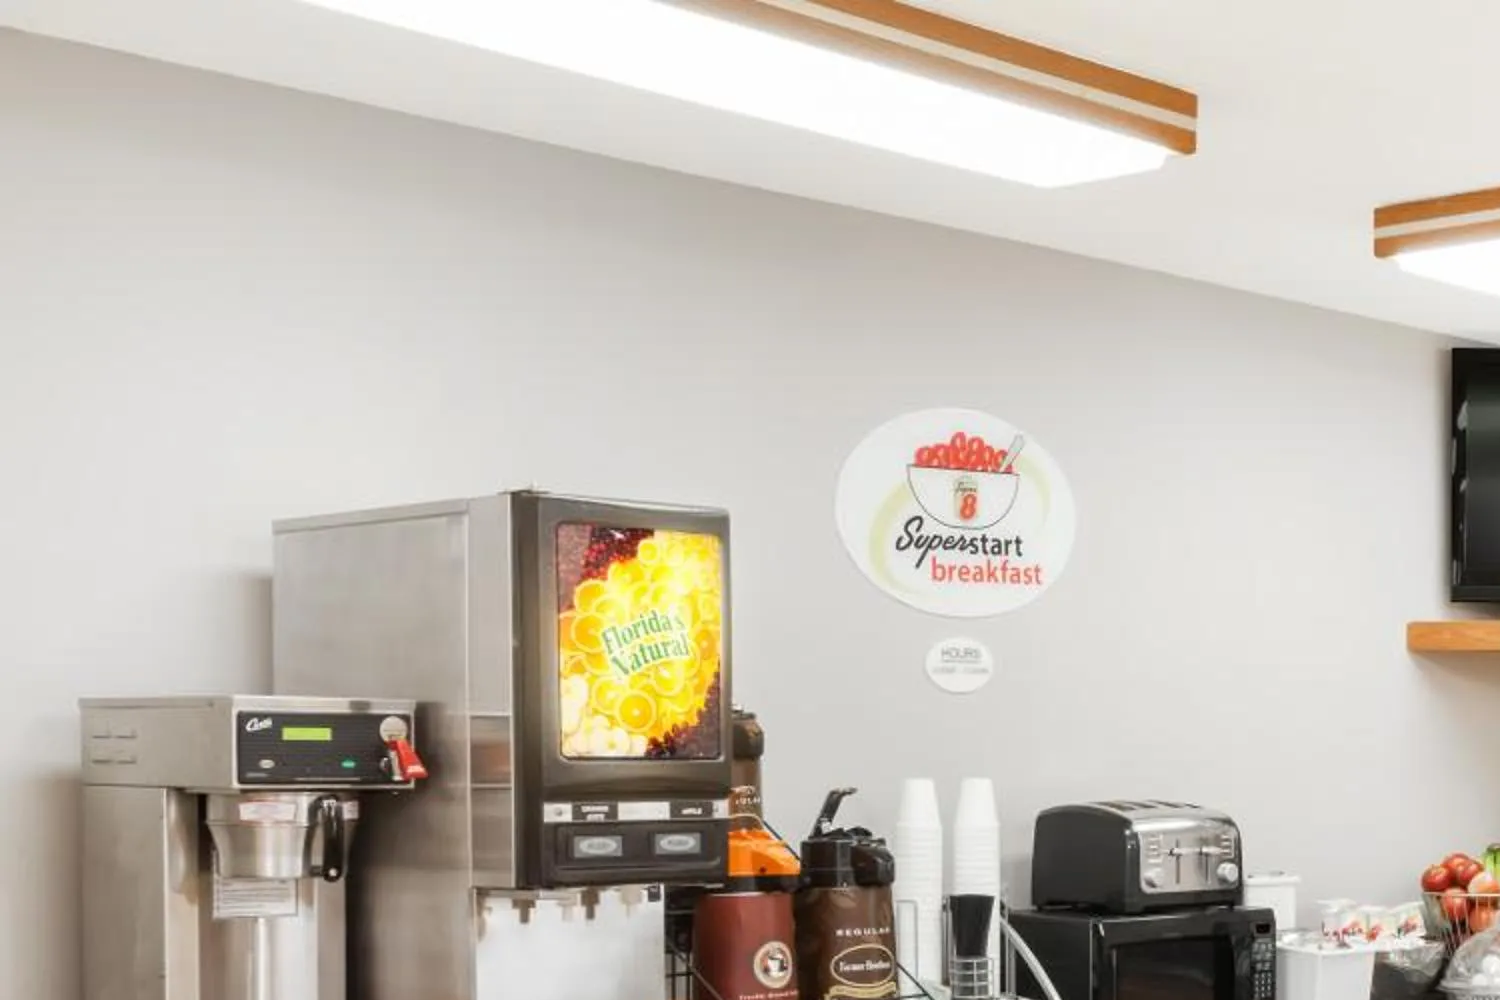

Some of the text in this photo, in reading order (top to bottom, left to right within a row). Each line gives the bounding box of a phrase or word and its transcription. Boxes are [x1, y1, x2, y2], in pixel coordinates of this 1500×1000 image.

[960, 493, 977, 520] 8
[931, 555, 1043, 585] breakfast
[611, 632, 689, 677] Natural
